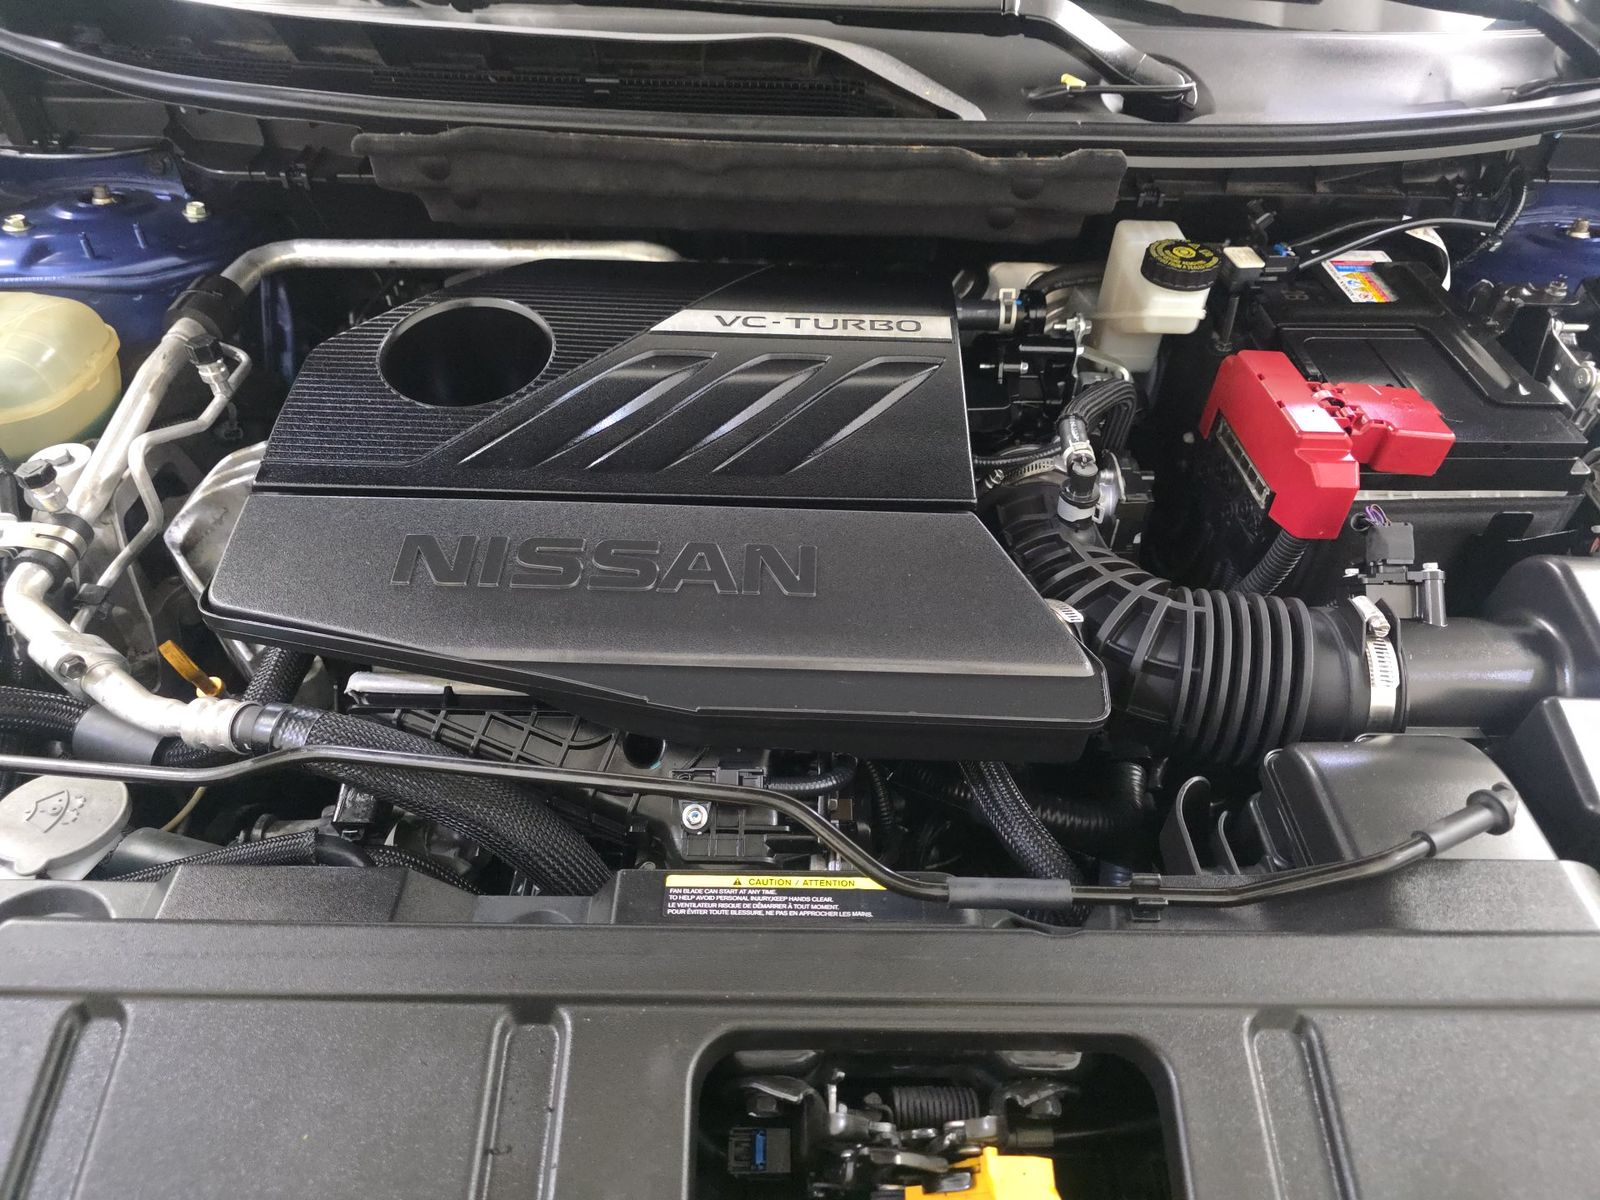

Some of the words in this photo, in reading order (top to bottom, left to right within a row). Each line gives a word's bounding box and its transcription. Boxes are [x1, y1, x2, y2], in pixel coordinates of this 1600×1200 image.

[715, 314, 922, 332] VC-TURBO
[390, 534, 818, 597] NISSAN
[802, 879, 855, 887] ATTENTION
